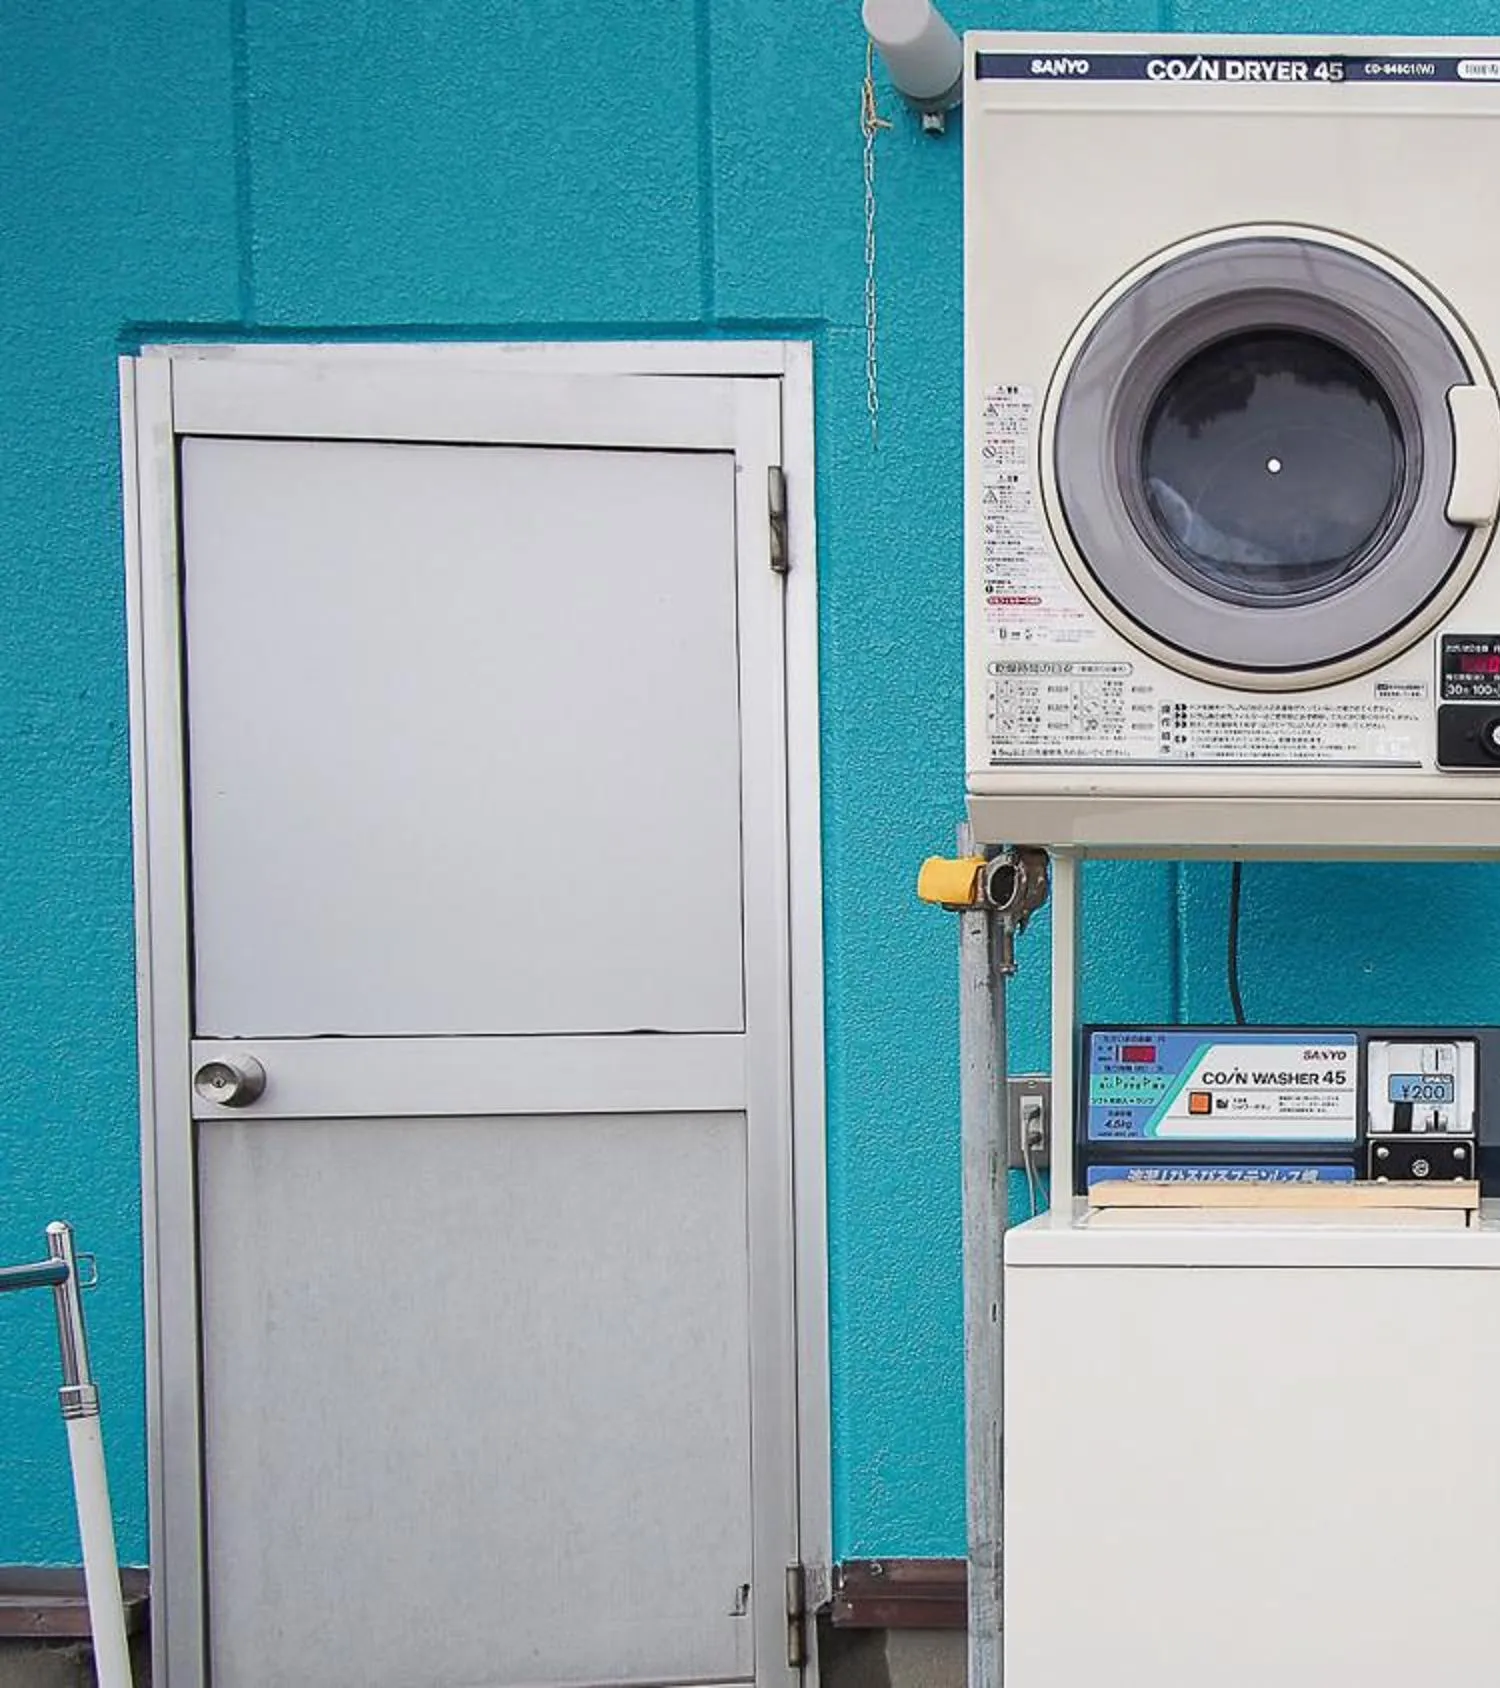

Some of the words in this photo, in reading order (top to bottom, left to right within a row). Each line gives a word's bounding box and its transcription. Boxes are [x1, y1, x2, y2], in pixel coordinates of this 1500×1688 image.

[1031, 58, 1090, 75] SANYO
[1225, 61, 1309, 81] DRYER
[1313, 62, 1345, 81] 45
[1303, 1050, 1347, 1061] SANYO
[1252, 1072, 1319, 1085] WASHER
[1322, 1070, 1347, 1085] 45
[1401, 1084, 1445, 1100] ¥200
